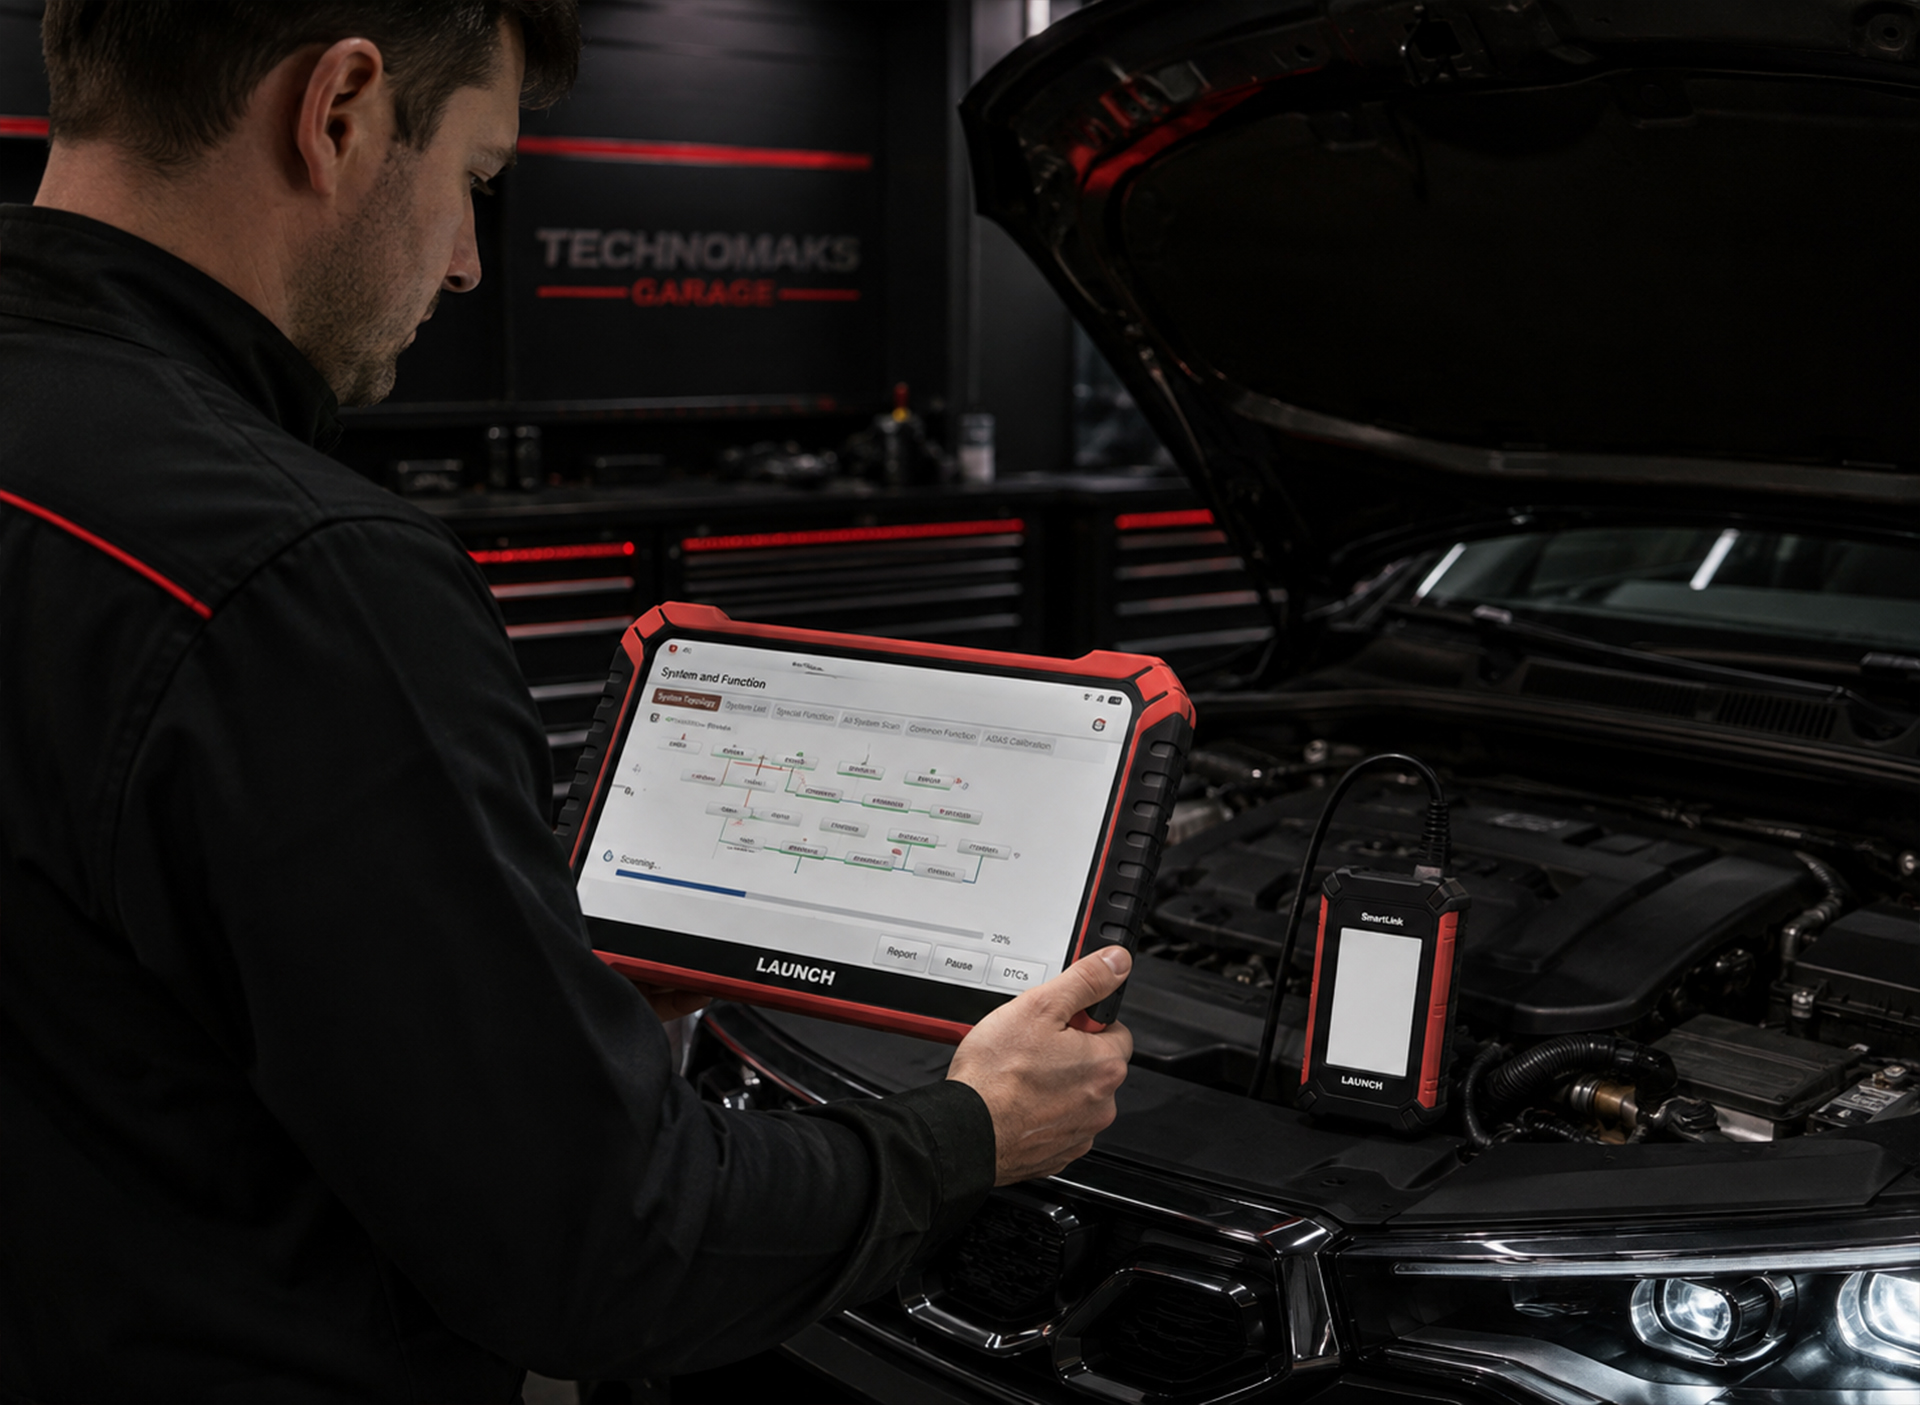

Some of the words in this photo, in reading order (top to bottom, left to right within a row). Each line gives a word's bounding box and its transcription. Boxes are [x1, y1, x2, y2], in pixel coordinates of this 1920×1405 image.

[537, 229, 860, 271] TECHNOMAKS
[631, 279, 775, 306] GARAGE
[661, 667, 698, 680] System
[699, 673, 720, 683] and
[721, 674, 766, 689] Function
[802, 711, 835, 722] Function
[909, 724, 942, 736] Common
[943, 729, 977, 741] Function
[1009, 737, 1052, 751] Calibration
[1361, 912, 1404, 926] SmartLink
[991, 933, 1011, 945] 20%
[886, 945, 918, 961] Report
[756, 957, 837, 986] LAUNCH
[945, 957, 973, 972] Pause
[1003, 967, 1029, 982] DTCs
[1341, 1075, 1383, 1090] LAUNCH
